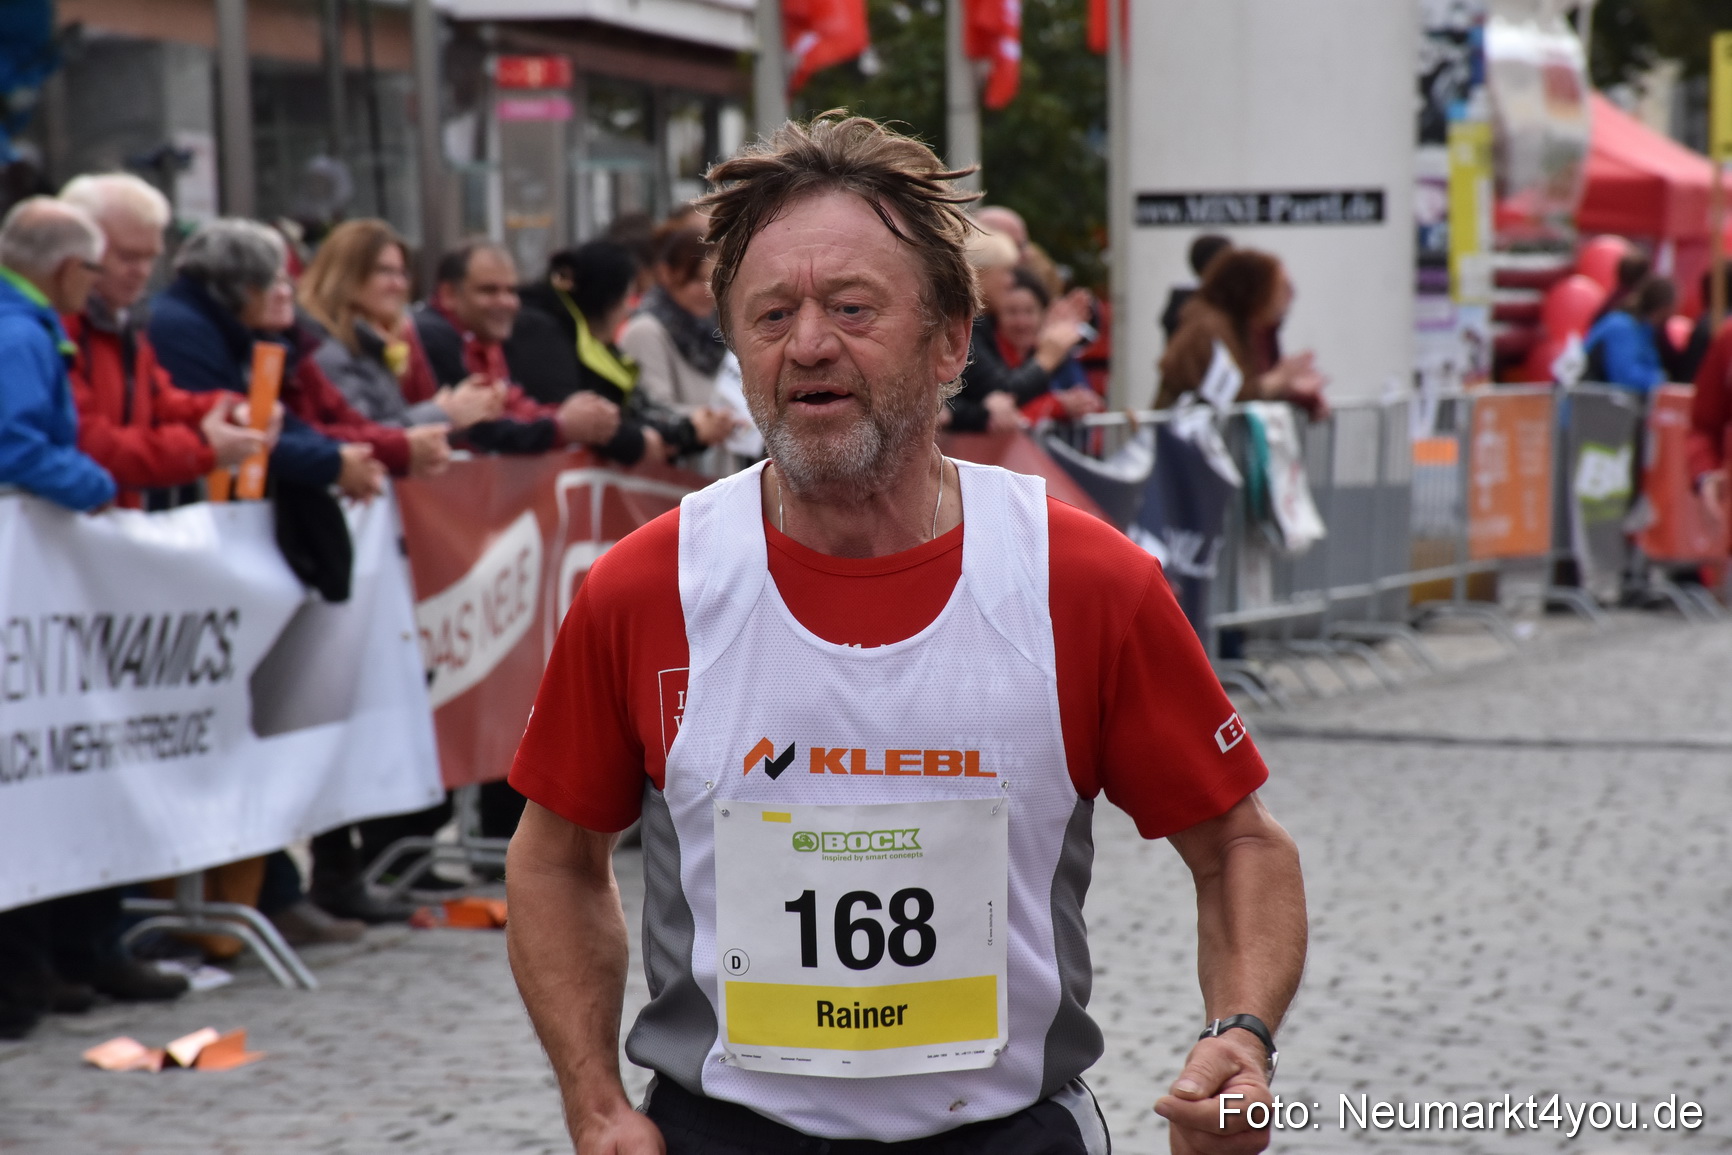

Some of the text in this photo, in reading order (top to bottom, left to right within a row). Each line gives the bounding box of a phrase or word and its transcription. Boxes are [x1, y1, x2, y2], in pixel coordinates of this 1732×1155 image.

[810, 748, 996, 777] KLEBL
[821, 828, 922, 853] BOCK
[821, 851, 924, 862] inspired by smart concepts
[784, 886, 937, 971] 168
[731, 955, 742, 970] D
[816, 1000, 908, 1029] Rainer
